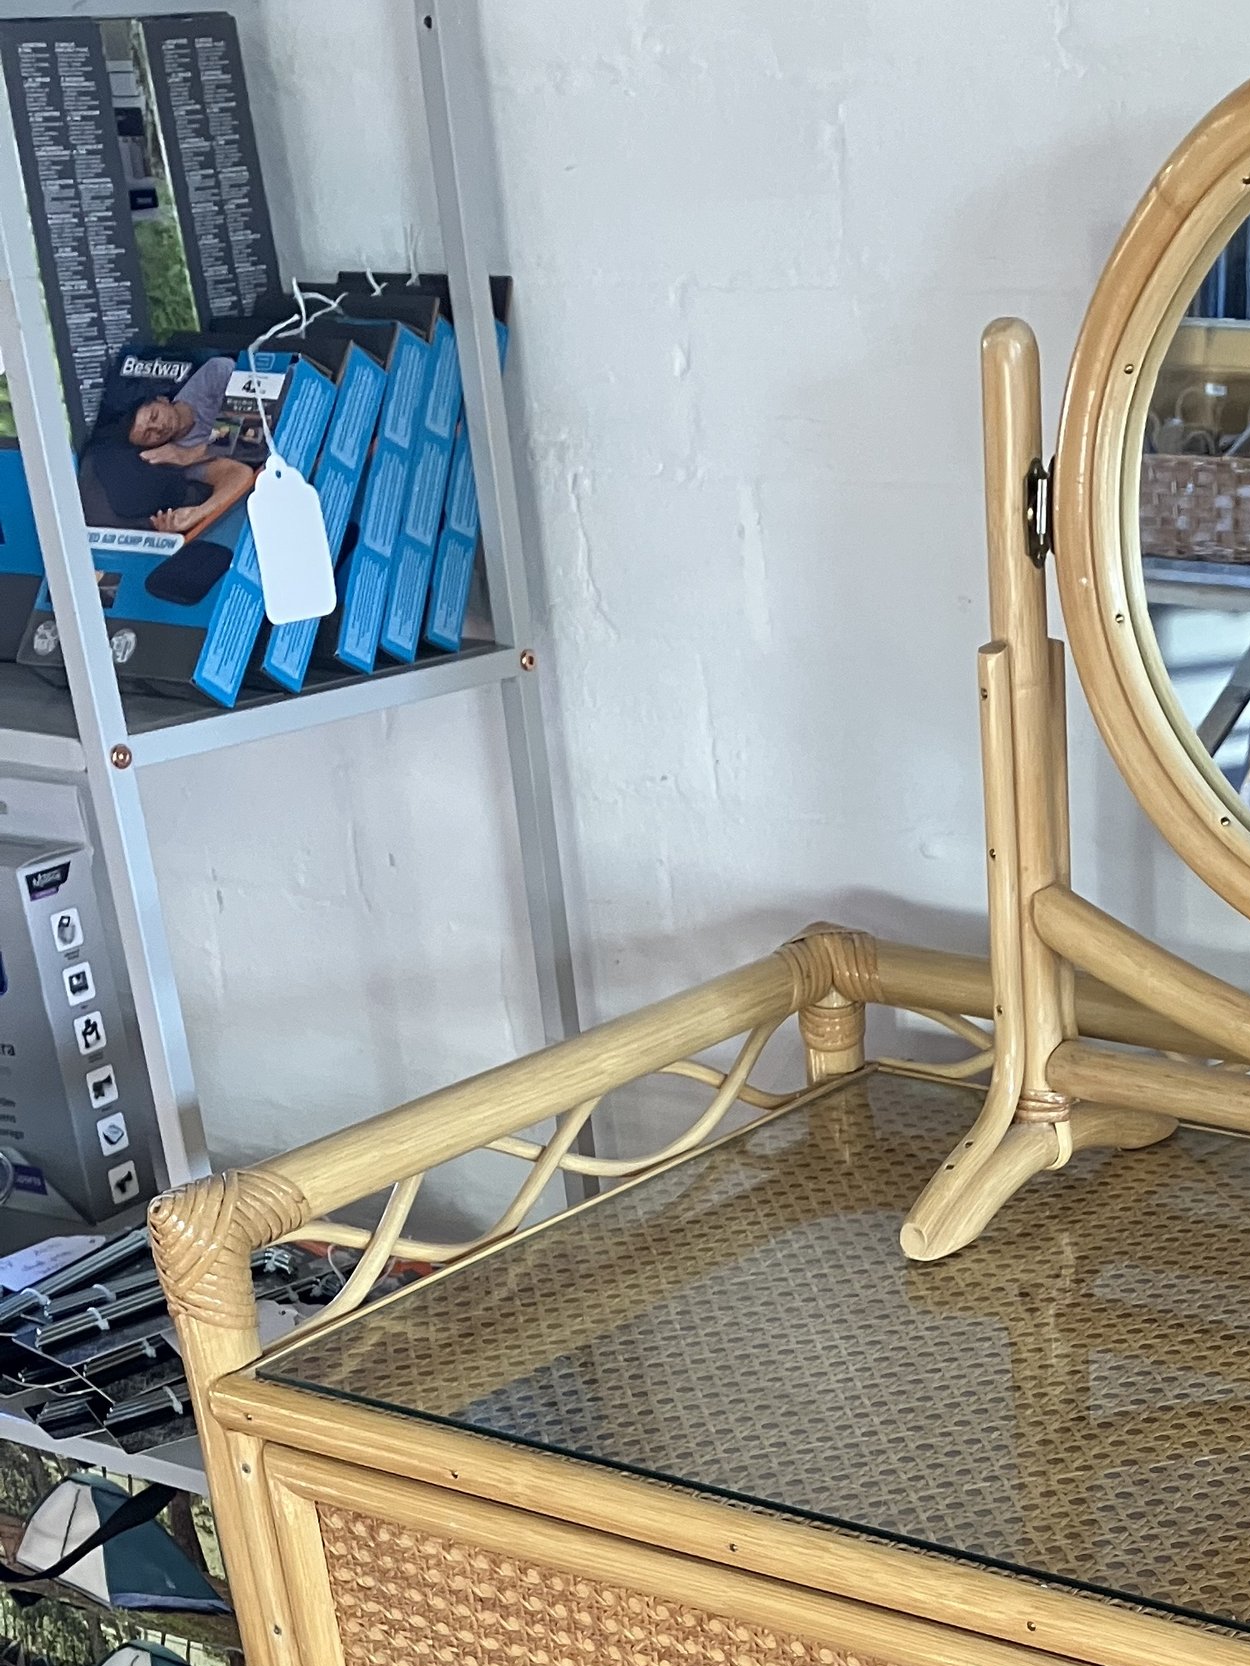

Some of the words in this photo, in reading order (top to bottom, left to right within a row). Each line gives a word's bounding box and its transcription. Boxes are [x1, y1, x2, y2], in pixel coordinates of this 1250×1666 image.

[121, 355, 192, 382] Bestway
[117, 534, 143, 546] CAMP
[143, 536, 178, 549] PILLOW
